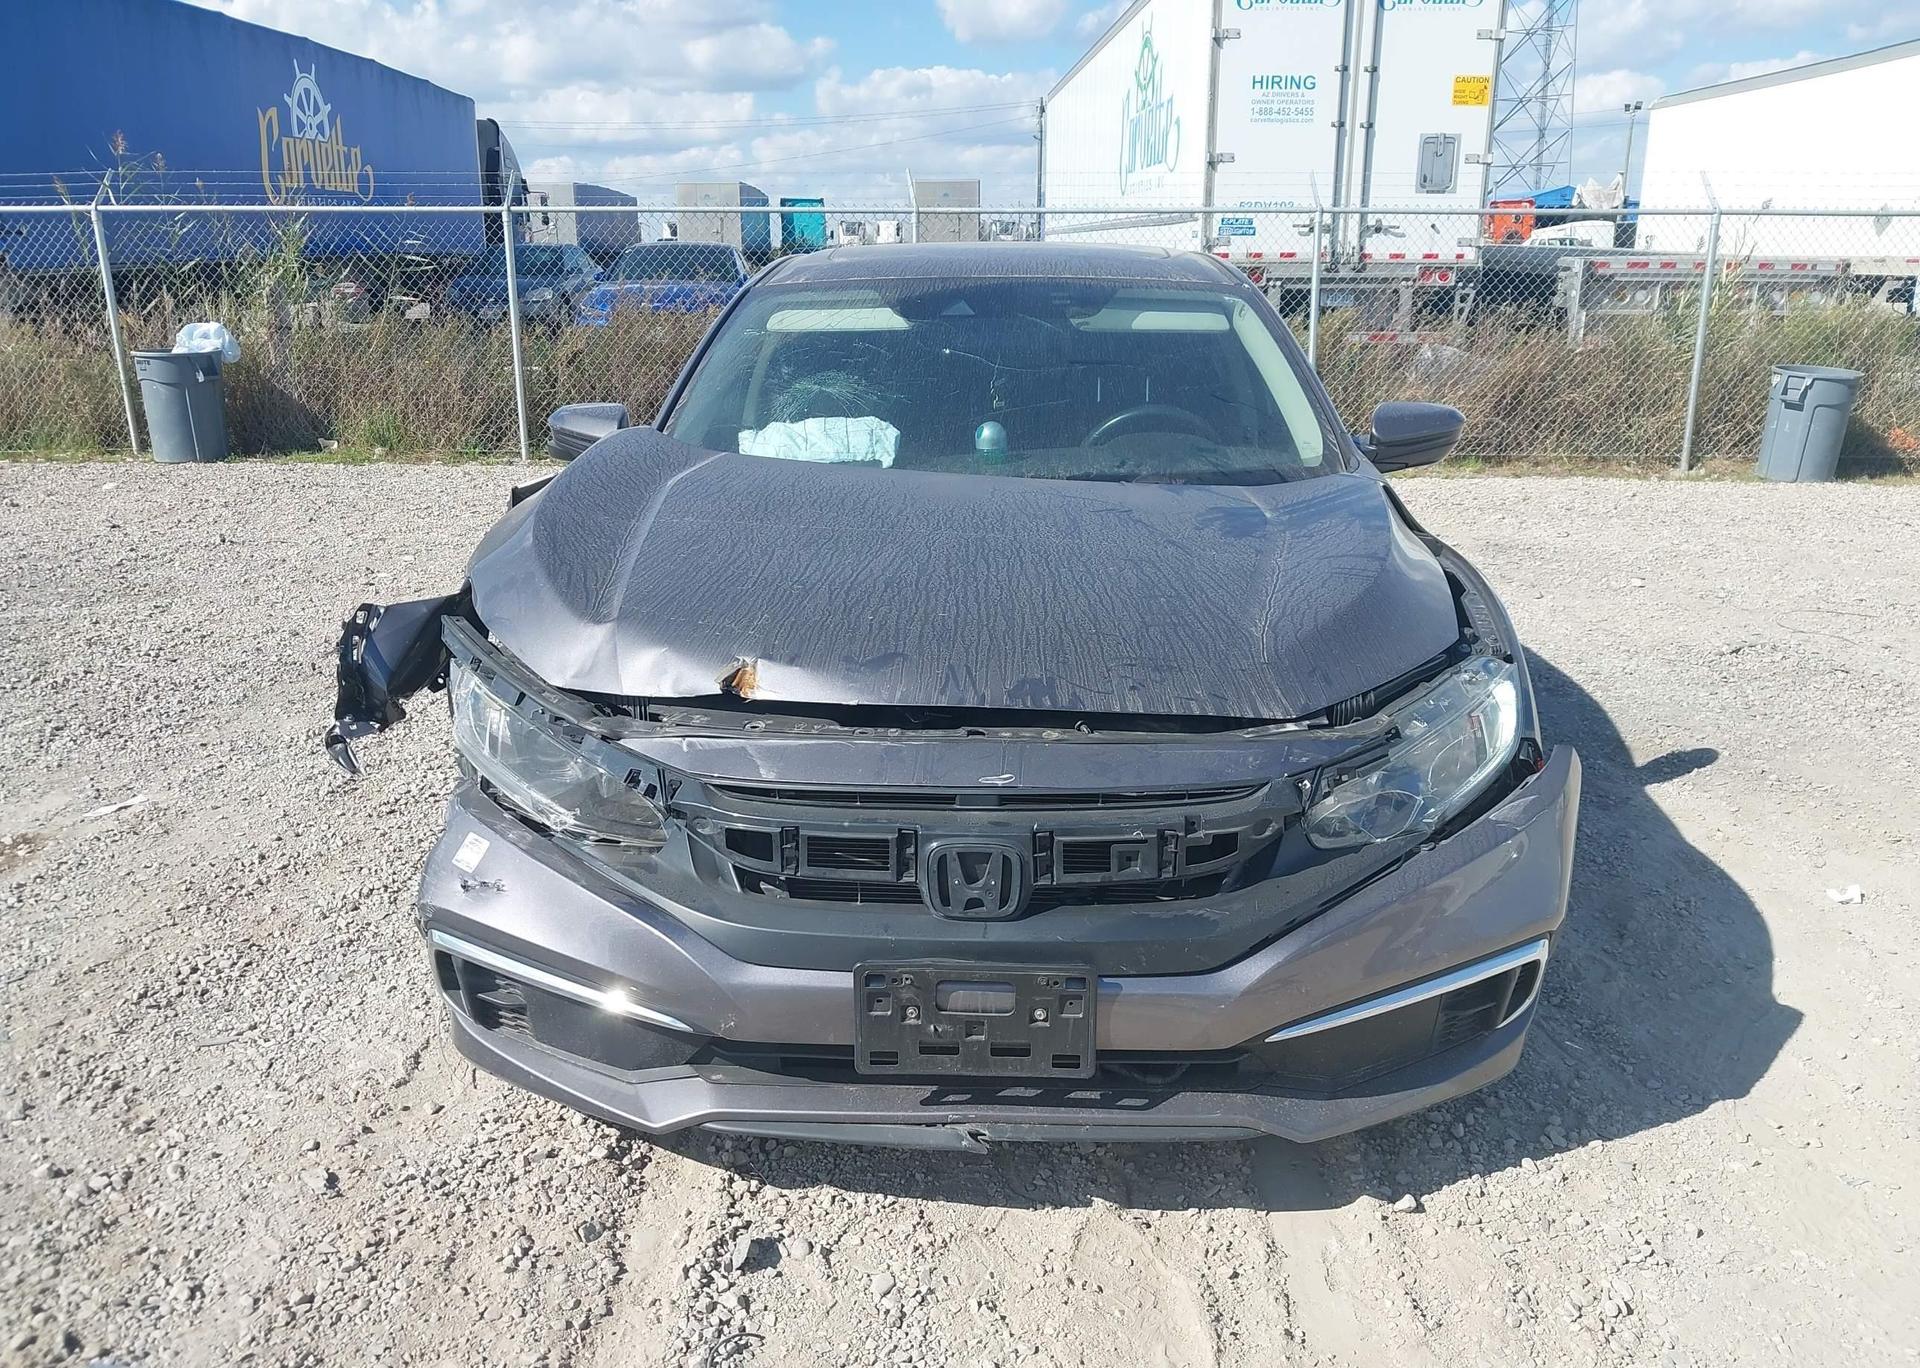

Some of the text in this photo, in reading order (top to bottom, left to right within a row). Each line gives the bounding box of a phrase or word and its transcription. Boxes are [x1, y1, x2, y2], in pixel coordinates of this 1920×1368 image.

[1252, 75, 1316, 90] HIRING
[1455, 76, 1490, 84] CAUTION
[1251, 107, 1315, 116] 1-888-452-5455
[257, 106, 375, 206] Corvette
